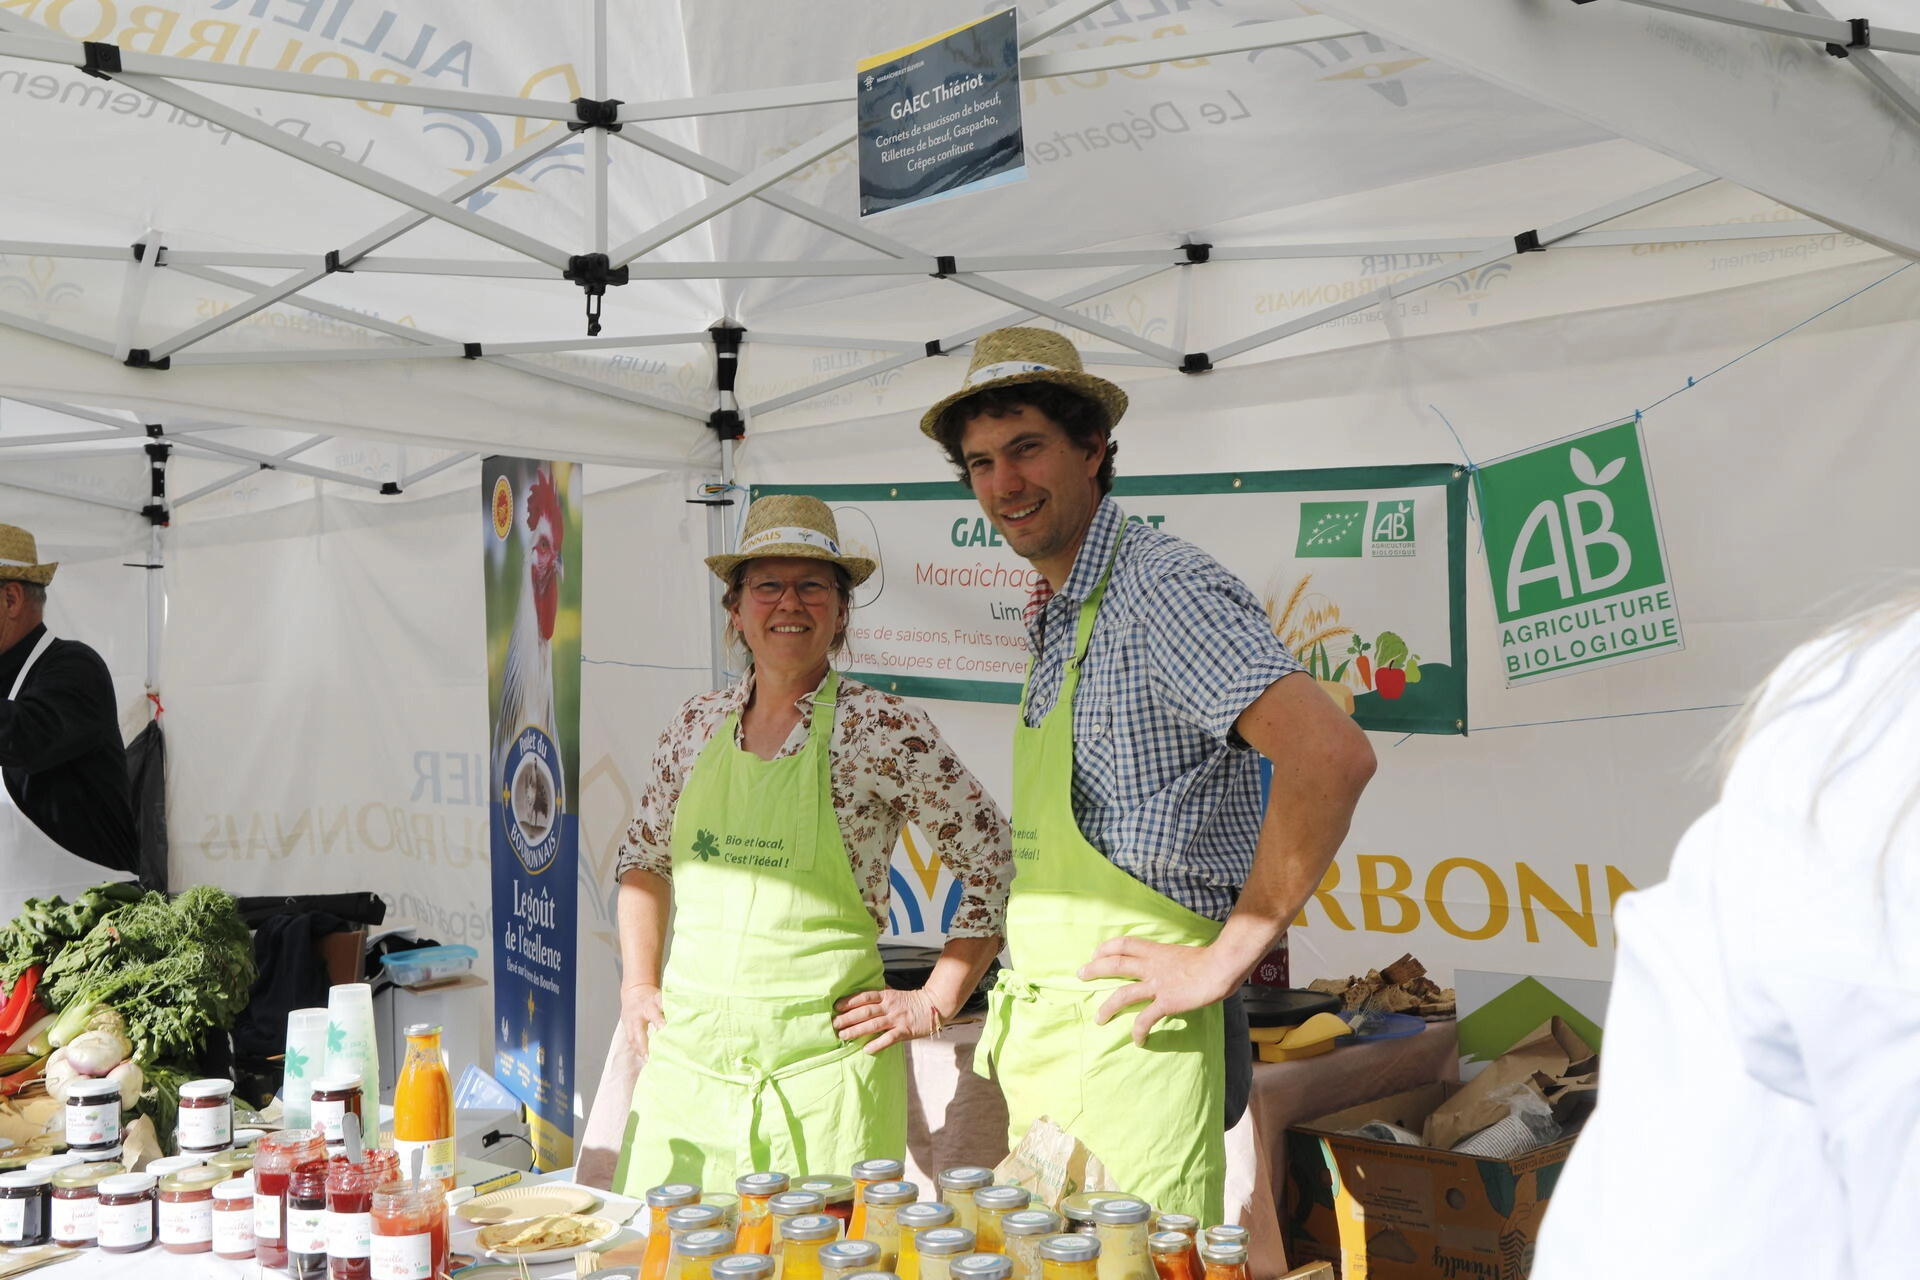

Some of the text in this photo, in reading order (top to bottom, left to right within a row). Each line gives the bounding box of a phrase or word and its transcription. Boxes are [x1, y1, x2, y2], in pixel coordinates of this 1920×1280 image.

[890, 73, 984, 120] GAEC Thiériot
[875, 91, 1002, 148] Cornets de saucisson de boeuf,
[881, 145, 915, 163] Rillettes
[916, 138, 928, 152] de
[953, 115, 999, 138] Gaspacho,
[907, 141, 975, 172] Crêpes confiture
[951, 516, 1003, 547] GAE
[1374, 512, 1408, 541] AB
[1506, 489, 1632, 613] AB
[916, 563, 1041, 593] Maraîchag
[991, 602, 1026, 621] Lim
[1502, 591, 1672, 647] AGRICULTURE
[874, 626, 893, 640] de
[896, 628, 951, 646] saisons,
[954, 629, 993, 646] Fruits
[995, 634, 1028, 652] roug
[1506, 618, 1678, 673] BIOLOGIQUE
[881, 651, 933, 671] Soupes
[937, 656, 952, 670] et
[956, 656, 1028, 674] Conserver
[519, 730, 547, 759] Poulet du
[725, 834, 785, 851] Bio et local,
[724, 852, 748, 865] C'est
[749, 853, 783, 868] l'idéal
[505, 921, 517, 951] de
